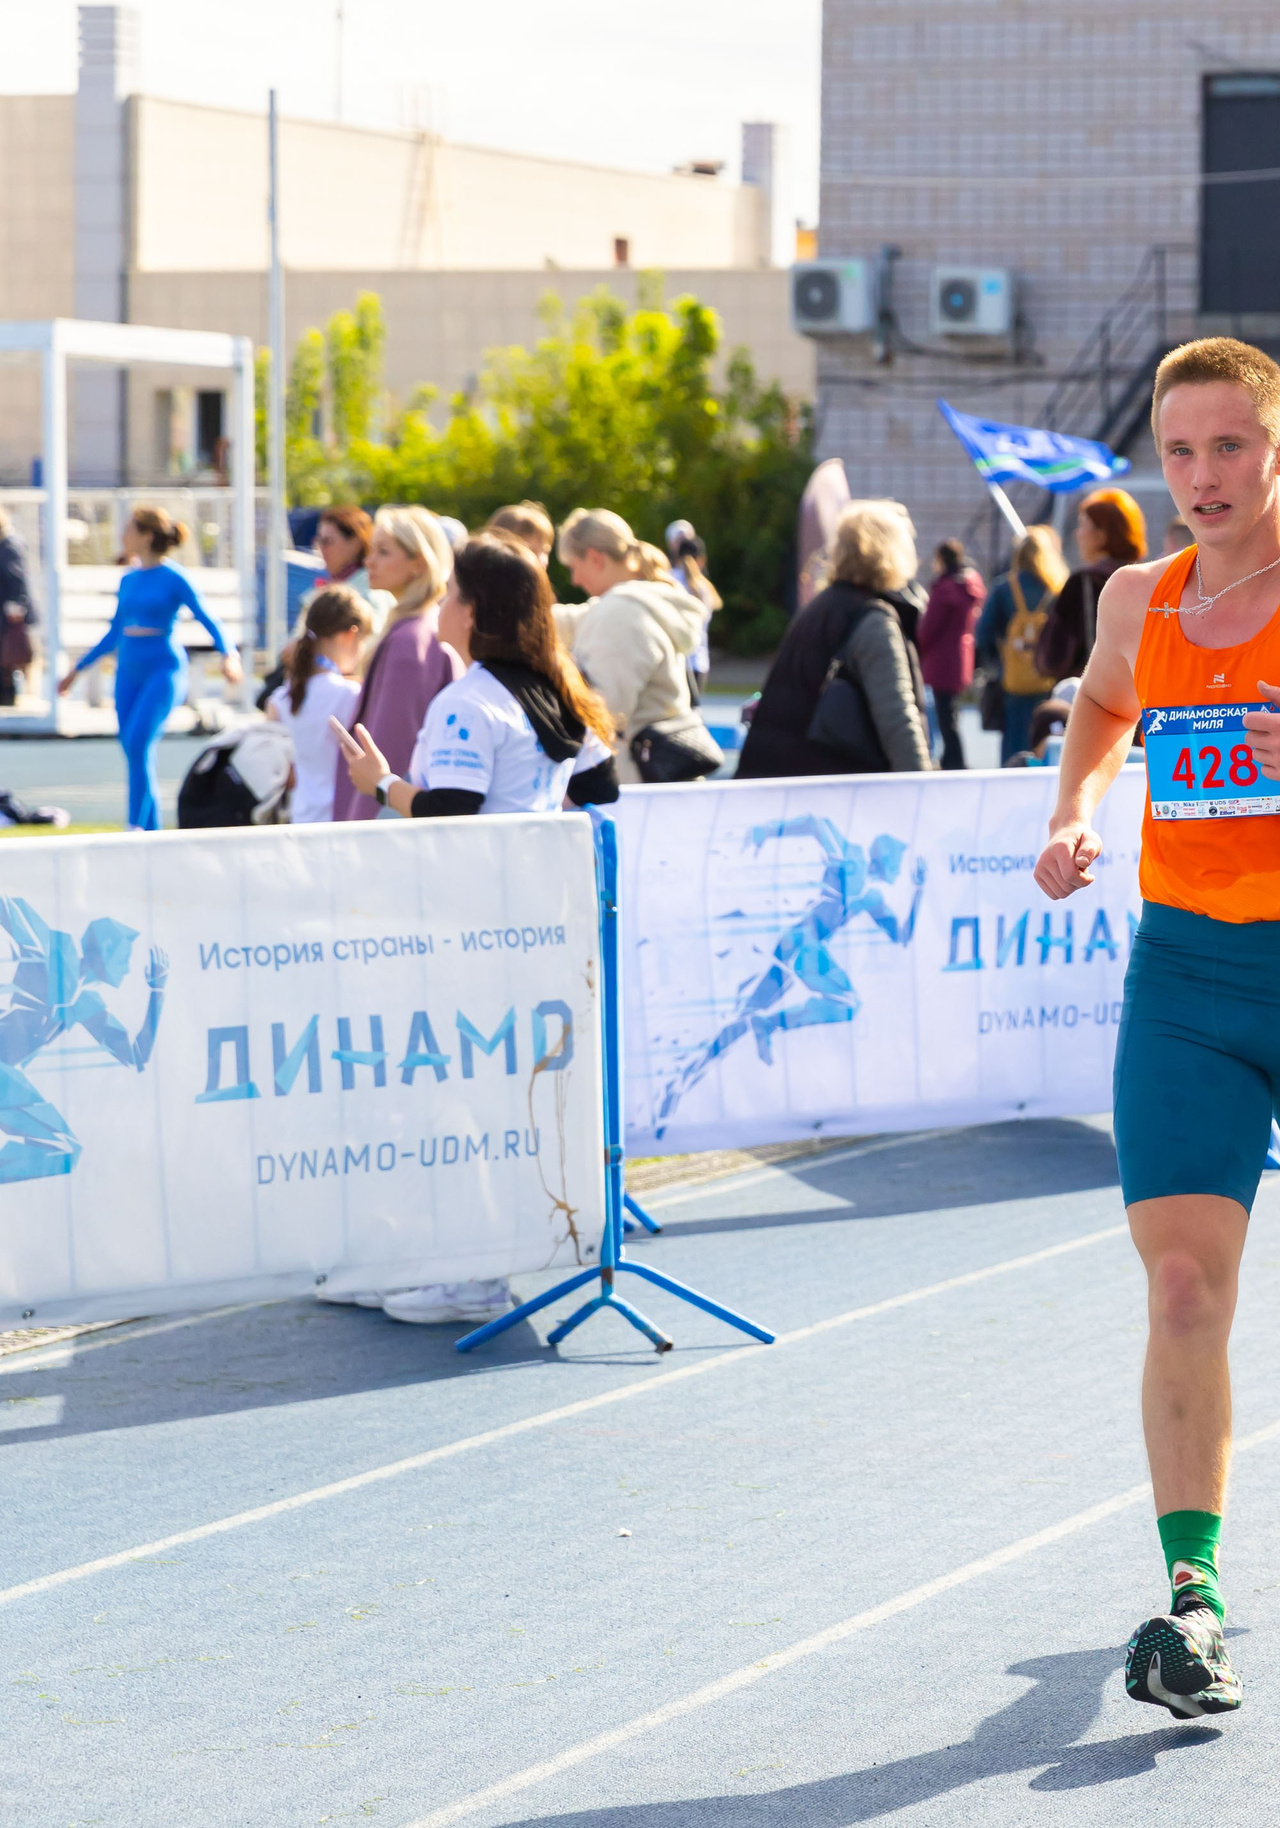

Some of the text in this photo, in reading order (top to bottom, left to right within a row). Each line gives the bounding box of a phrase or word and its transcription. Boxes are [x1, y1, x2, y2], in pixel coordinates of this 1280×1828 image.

[1168, 707, 1248, 721] ДИНАМОВСКАЯ
[1193, 719, 1223, 730] МИЛЯ
[1172, 744, 1258, 789] 428
[199, 940, 325, 971] История
[333, 932, 434, 962] страны
[461, 925, 566, 951] история
[194, 1000, 574, 1104] ДИНАМО
[257, 1128, 541, 1185] DYNAMO-UDM.RU
